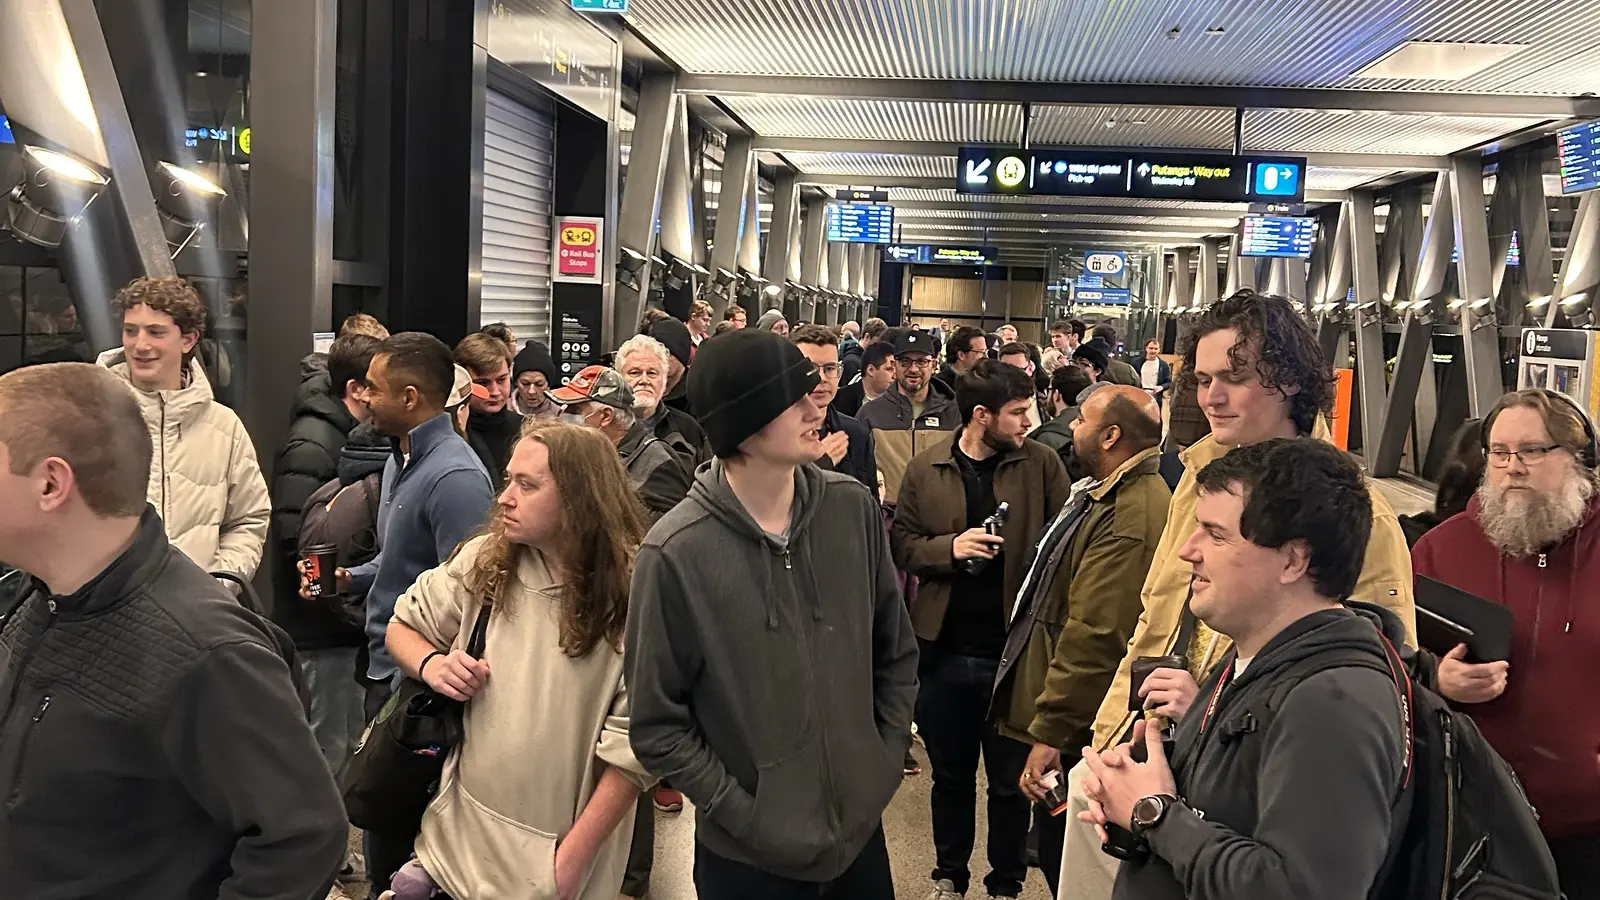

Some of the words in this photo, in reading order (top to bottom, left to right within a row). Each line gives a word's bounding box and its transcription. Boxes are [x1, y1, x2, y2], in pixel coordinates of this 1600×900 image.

[1151, 164, 1190, 177] Putanga
[1193, 166, 1214, 179] Way
[1213, 167, 1231, 178] out
[1067, 173, 1095, 185] Pick-up
[569, 250, 582, 258] Rail
[568, 259, 588, 267] Stops
